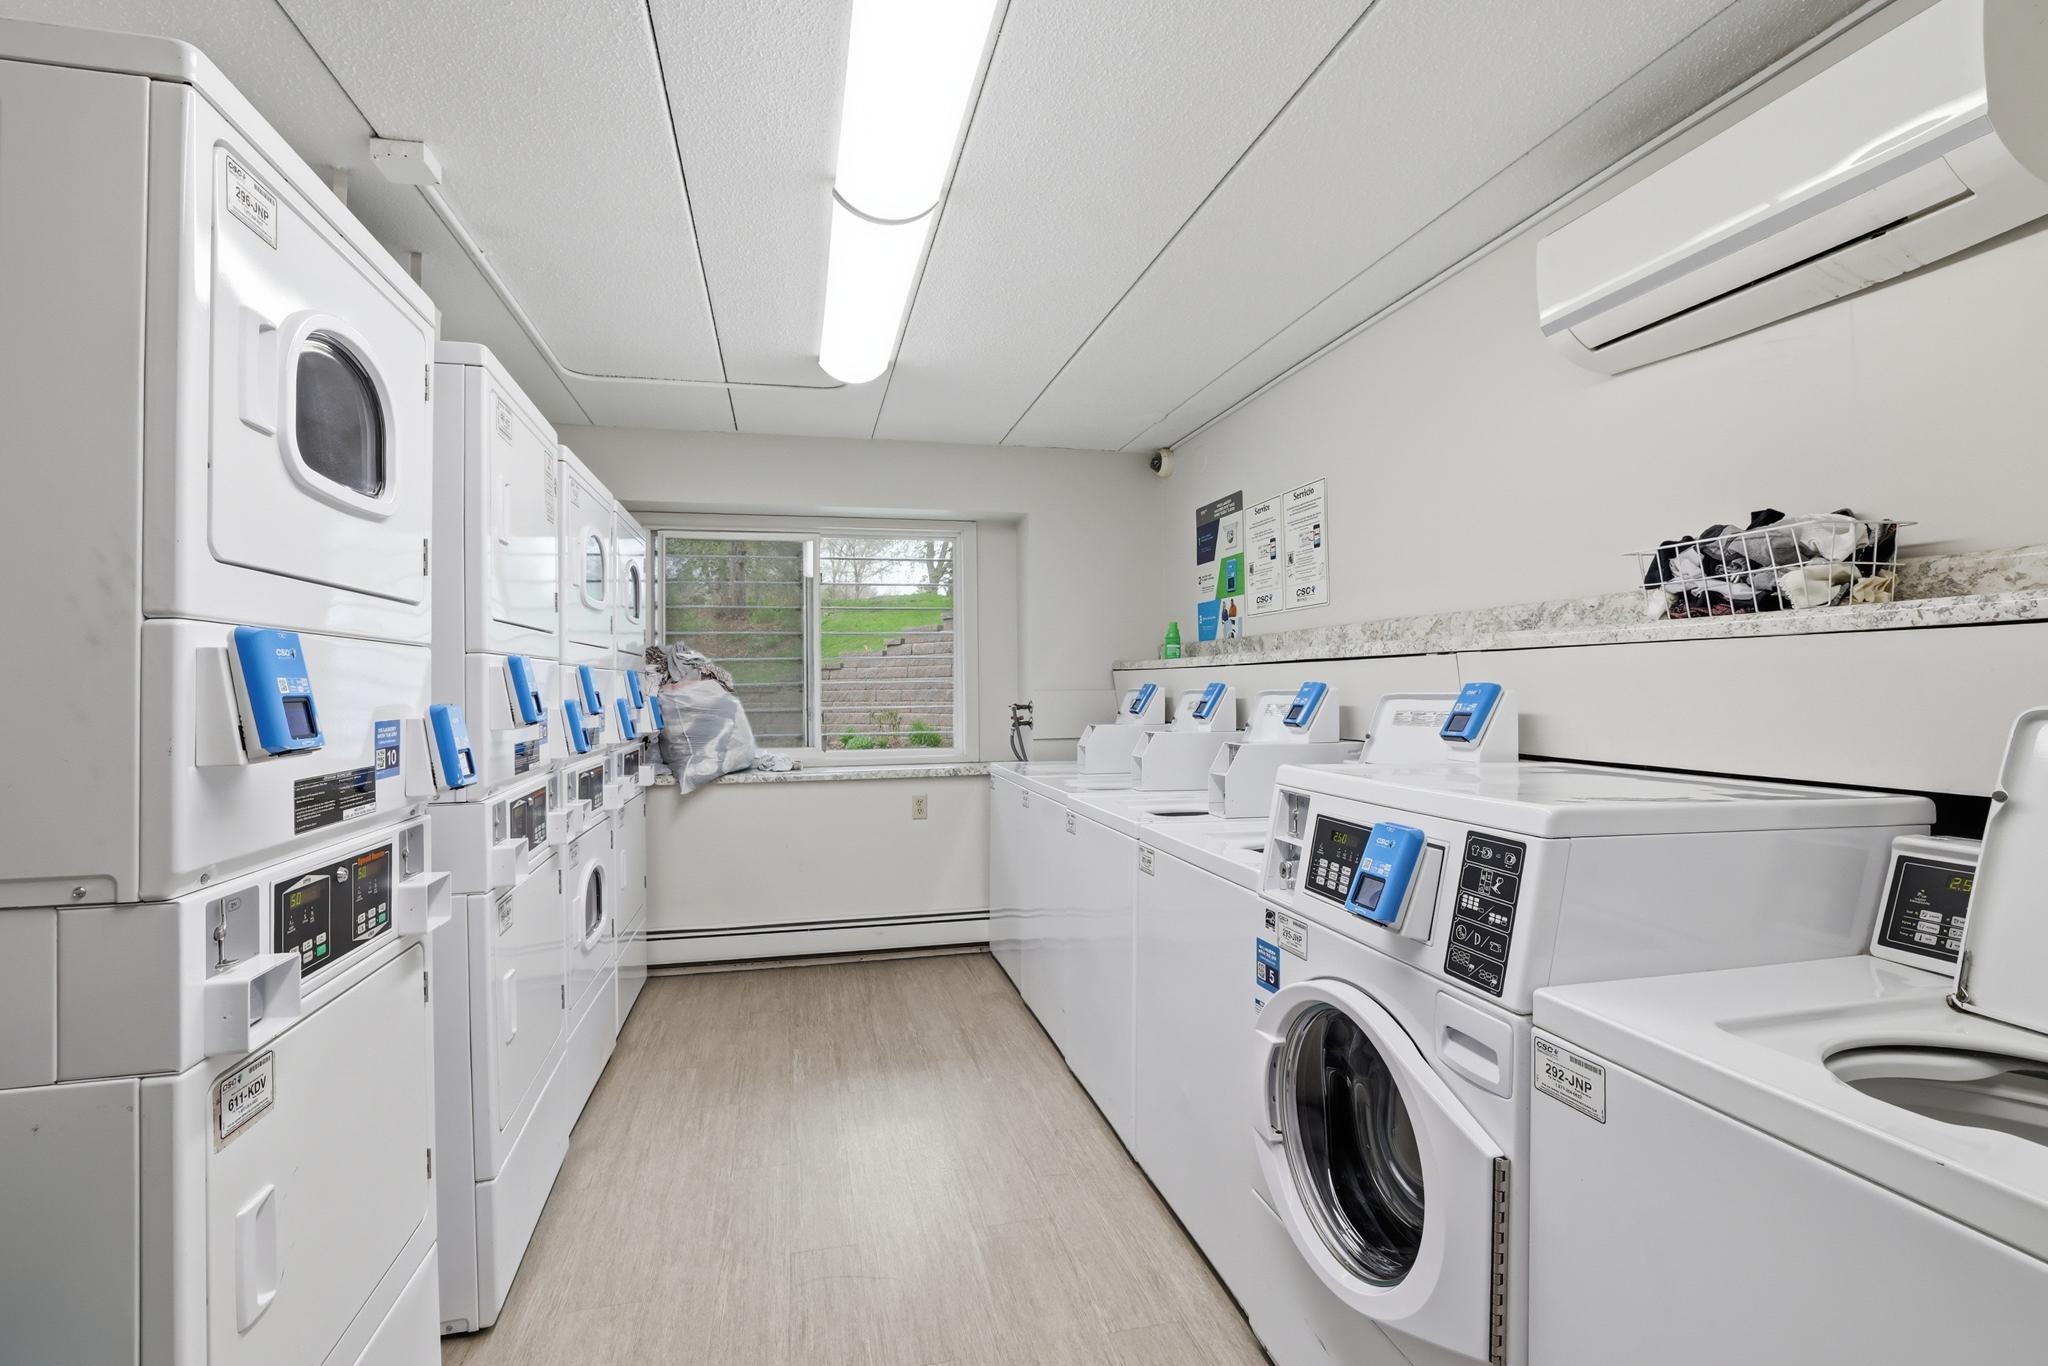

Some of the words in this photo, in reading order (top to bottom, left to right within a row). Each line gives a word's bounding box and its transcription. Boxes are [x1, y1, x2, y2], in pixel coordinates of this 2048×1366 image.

[235, 186, 269, 220] 296-JNP
[1293, 487, 1314, 501] Servicio
[1254, 504, 1270, 516] Service
[1296, 586, 1311, 597] CSC
[1256, 594, 1269, 604] CSC
[386, 749, 397, 766] 10
[1269, 970, 1275, 984] 5
[1536, 1041, 1554, 1055] CSC
[1545, 1063, 1593, 1094] 292-JNP
[228, 1075, 267, 1112] 611-KDV
